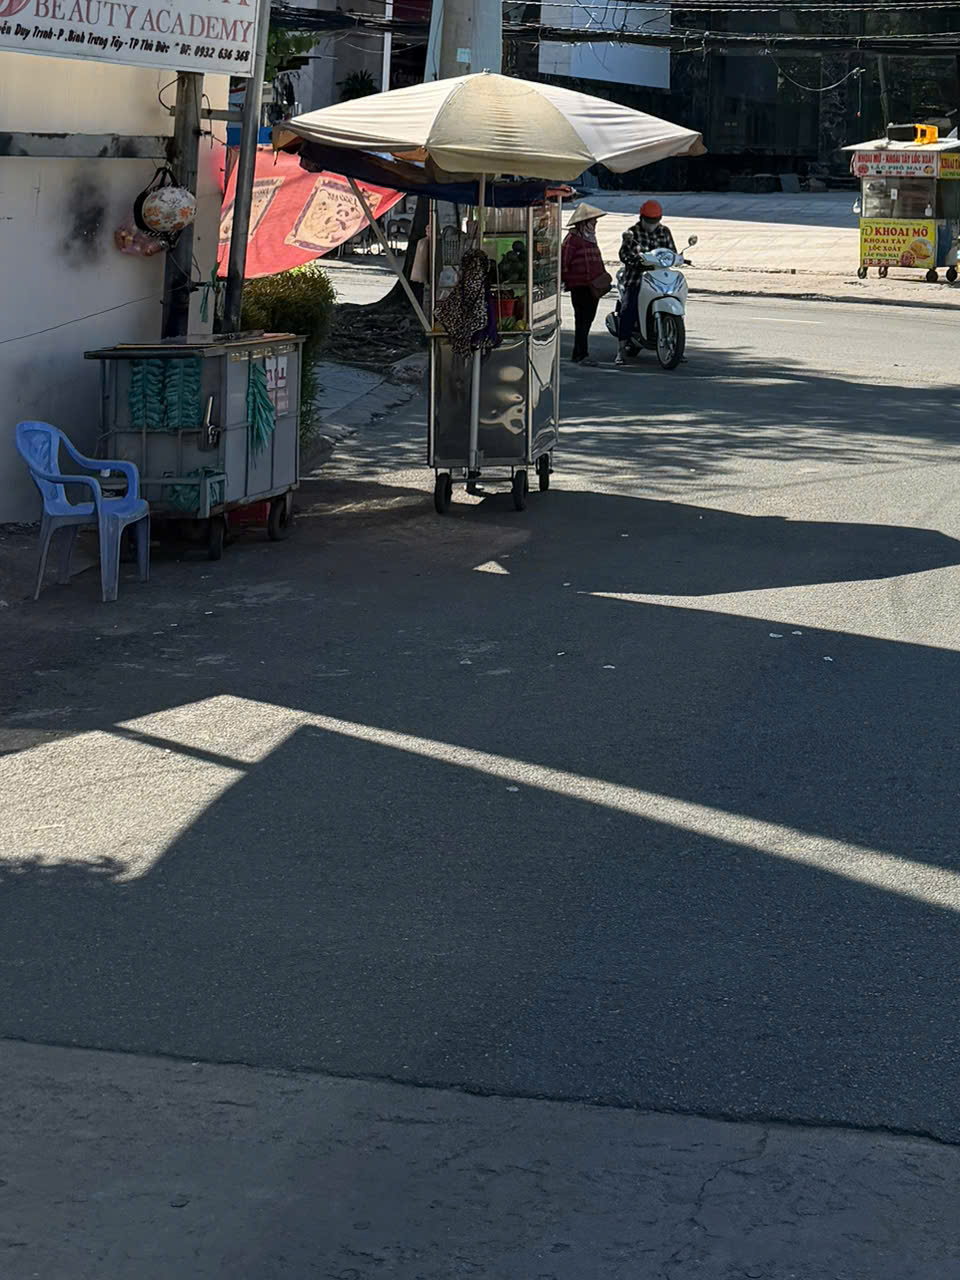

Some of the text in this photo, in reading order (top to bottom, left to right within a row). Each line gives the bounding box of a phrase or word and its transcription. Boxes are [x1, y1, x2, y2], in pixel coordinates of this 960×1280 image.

[140, 8, 254, 43] ACADEMY
[194, 46, 215, 58] 0932
[875, 227, 909, 237] KHOAI
